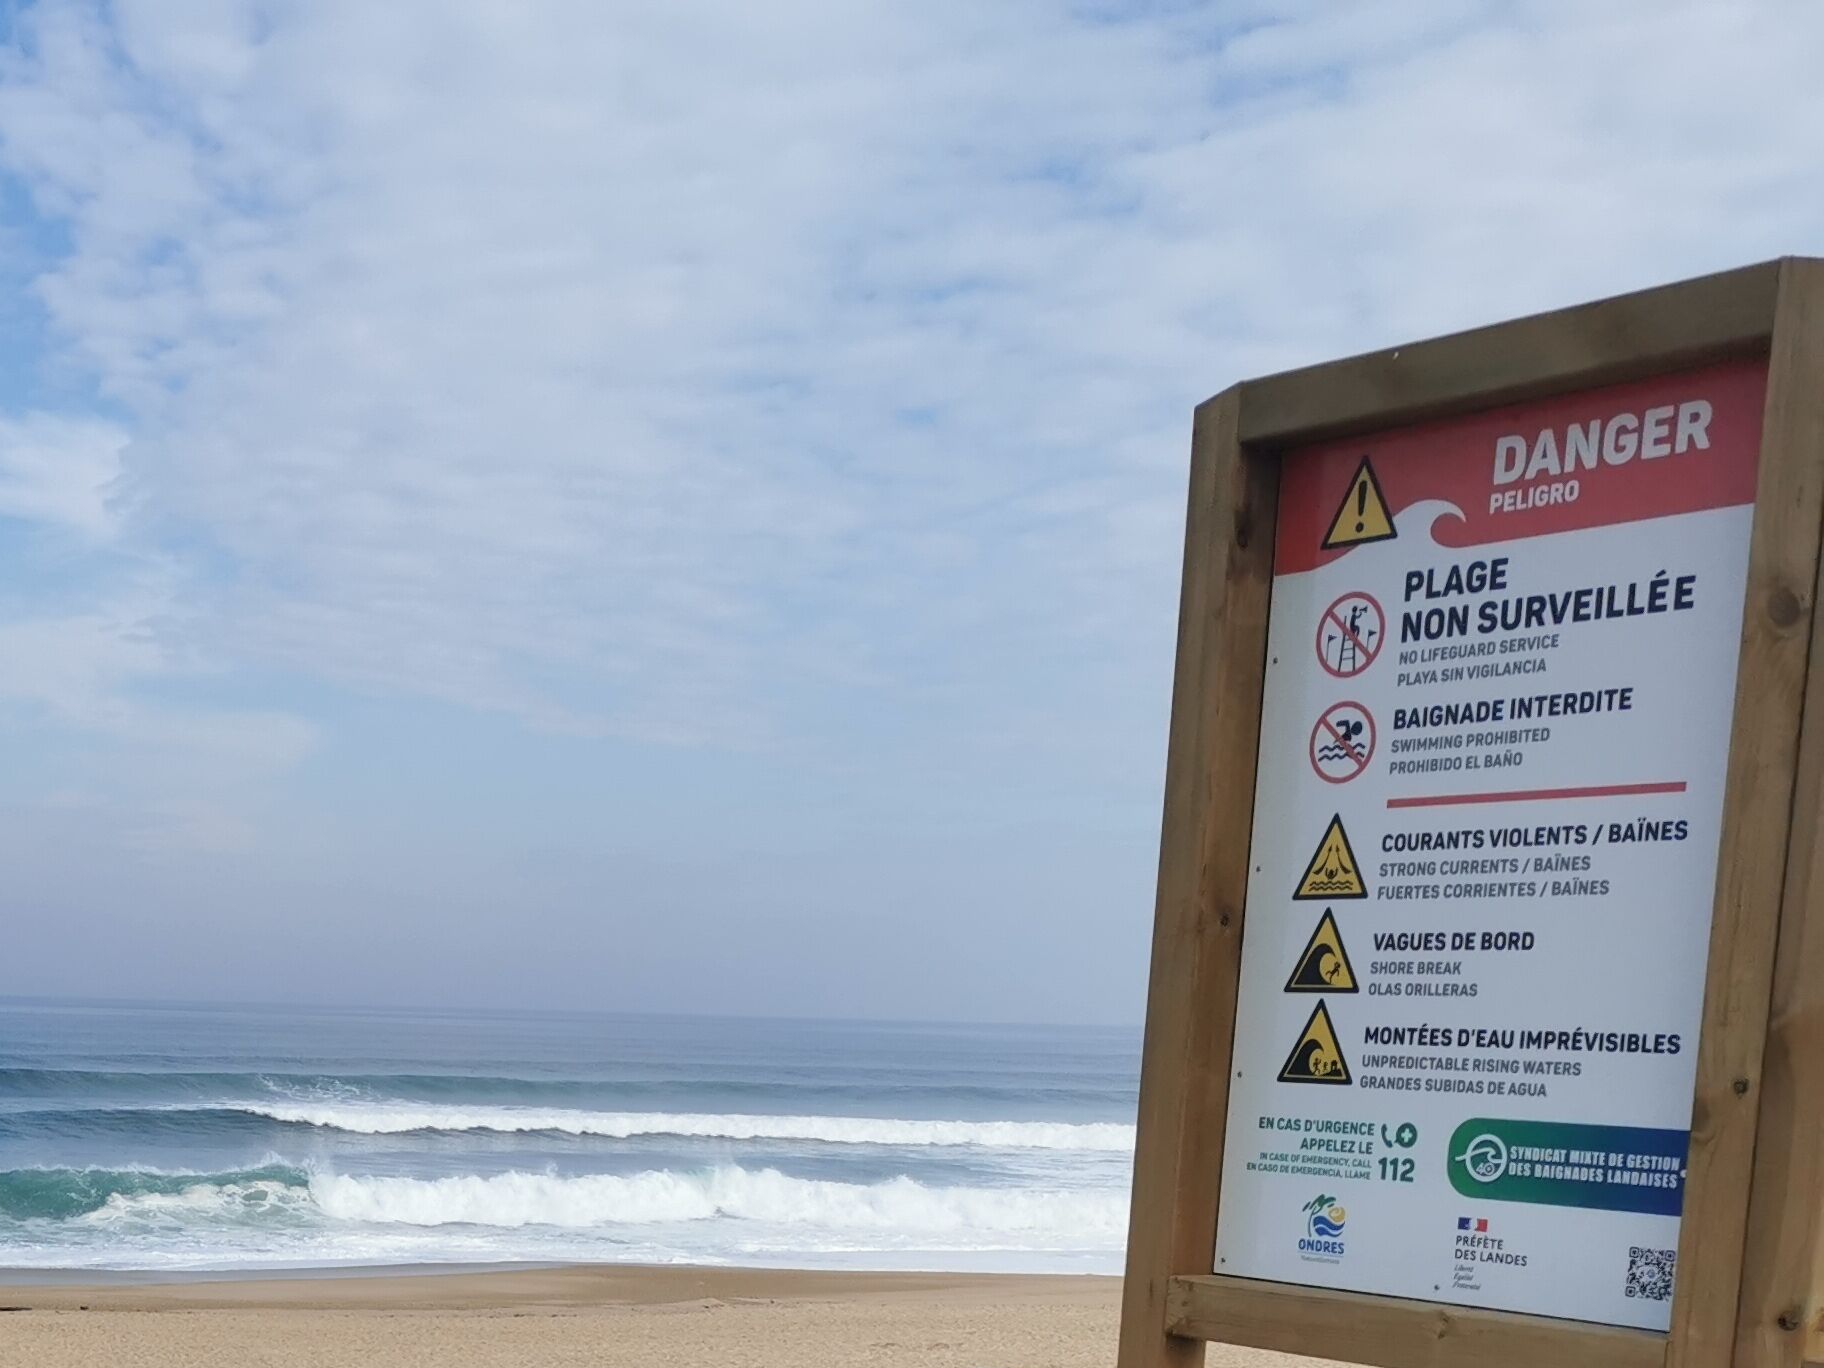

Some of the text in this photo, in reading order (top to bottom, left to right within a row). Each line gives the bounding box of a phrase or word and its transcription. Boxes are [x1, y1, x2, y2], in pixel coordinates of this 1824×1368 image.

[1493, 400, 1712, 485] DANGER
[1489, 480, 1580, 514] PELIGRO
[1403, 558, 1509, 602] PLAGE
[1401, 570, 1697, 643] NON SURVEILLÉE
[1399, 634, 1560, 665] NO LIFEGUARD SERVICE
[1397, 658, 1547, 687] PLAYA SIN VIGILANCIA
[1393, 687, 1634, 730] BAIGNADE INTERDITE
[1391, 727, 1550, 753] SWIMMING PROHIBITED
[1389, 749, 1523, 775] PROHIBIDO EL BAÑO
[1381, 817, 1689, 853] COURANTS VIOLENTS / BAÏNES
[1379, 853, 1591, 877] STRONG CURRENTS / BAÏNES
[1377, 877, 1610, 900] FUERTES CORRIENTES / BAÏNES
[1373, 931, 1535, 951] VAGUES DE BORD
[1370, 961, 1462, 975] SHORE BREAK
[1368, 982, 1478, 997] OLAS ORILLERAS
[1364, 1024, 1681, 1055] MONTÉES D'EAU IMPRÉVISIBLES
[1362, 1054, 1582, 1076] UNPREDICTABLE RISING WATERS
[1359, 1075, 1547, 1097] GRANDES SUBIDAS DE AGUA
[1258, 1116, 1375, 1136] EN CAS D'URGENCE
[1300, 1137, 1374, 1154] APPELEZ LE
[1510, 1145, 1681, 1171] SYNDICAT MIXTE DE GESTION
[1247, 1162, 1256, 1171] EN
[1258, 1163, 1278, 1173] CASO
[1280, 1165, 1290, 1173] DE
[1344, 1170, 1371, 1180] LLAME
[1260, 1152, 1268, 1161] IN
[1270, 1153, 1289, 1162] CASE
[1291, 1154, 1300, 1162] OF
[1352, 1159, 1372, 1169] CALL
[1378, 1156, 1415, 1183] 112
[1508, 1162, 1678, 1189] DES BAIGNADES LANDAISES
[1298, 1238, 1345, 1254] ONDRES
[1456, 1234, 1504, 1250] PRÉFÈTE
[1454, 1248, 1528, 1267] DES LANDES
